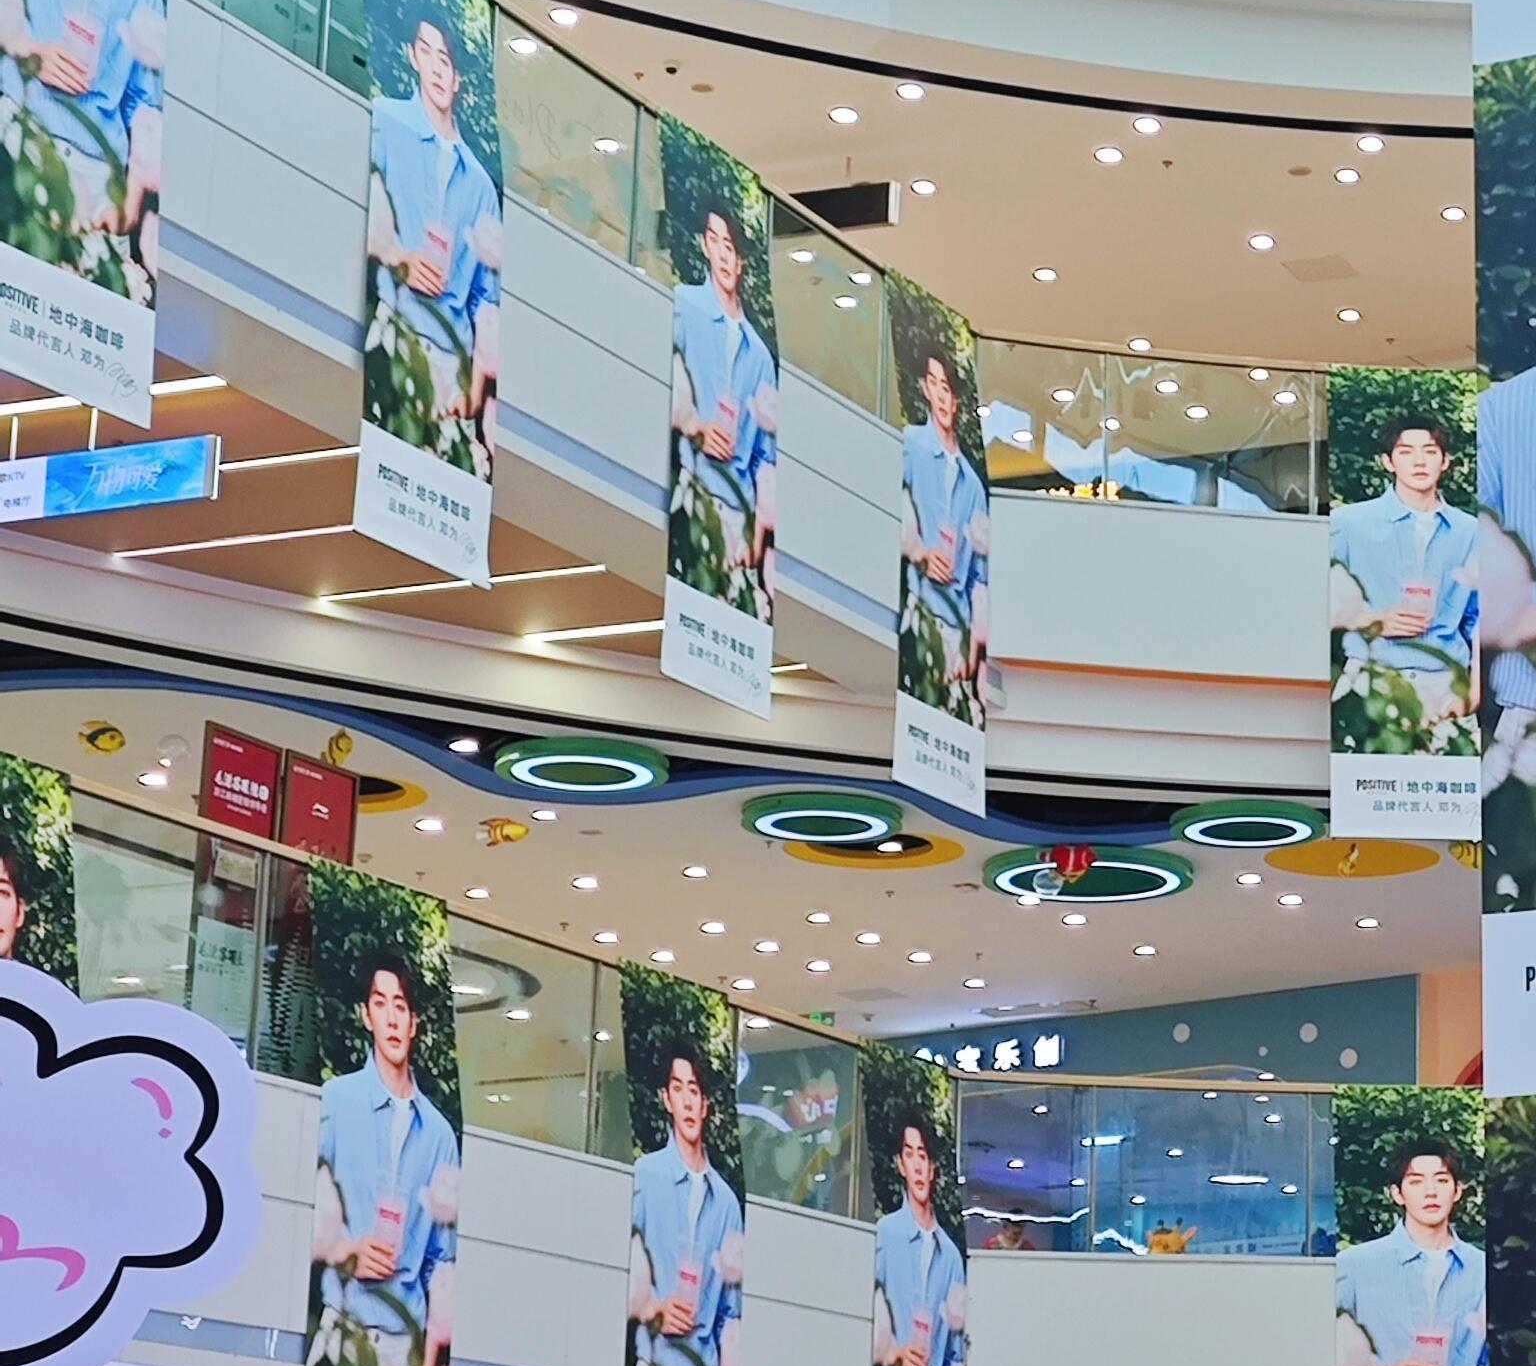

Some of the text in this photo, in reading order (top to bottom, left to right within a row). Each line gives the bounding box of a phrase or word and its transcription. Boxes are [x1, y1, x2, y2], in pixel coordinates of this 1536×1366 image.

[1356, 779, 1476, 794] POSITIVE 地中海咖啡
